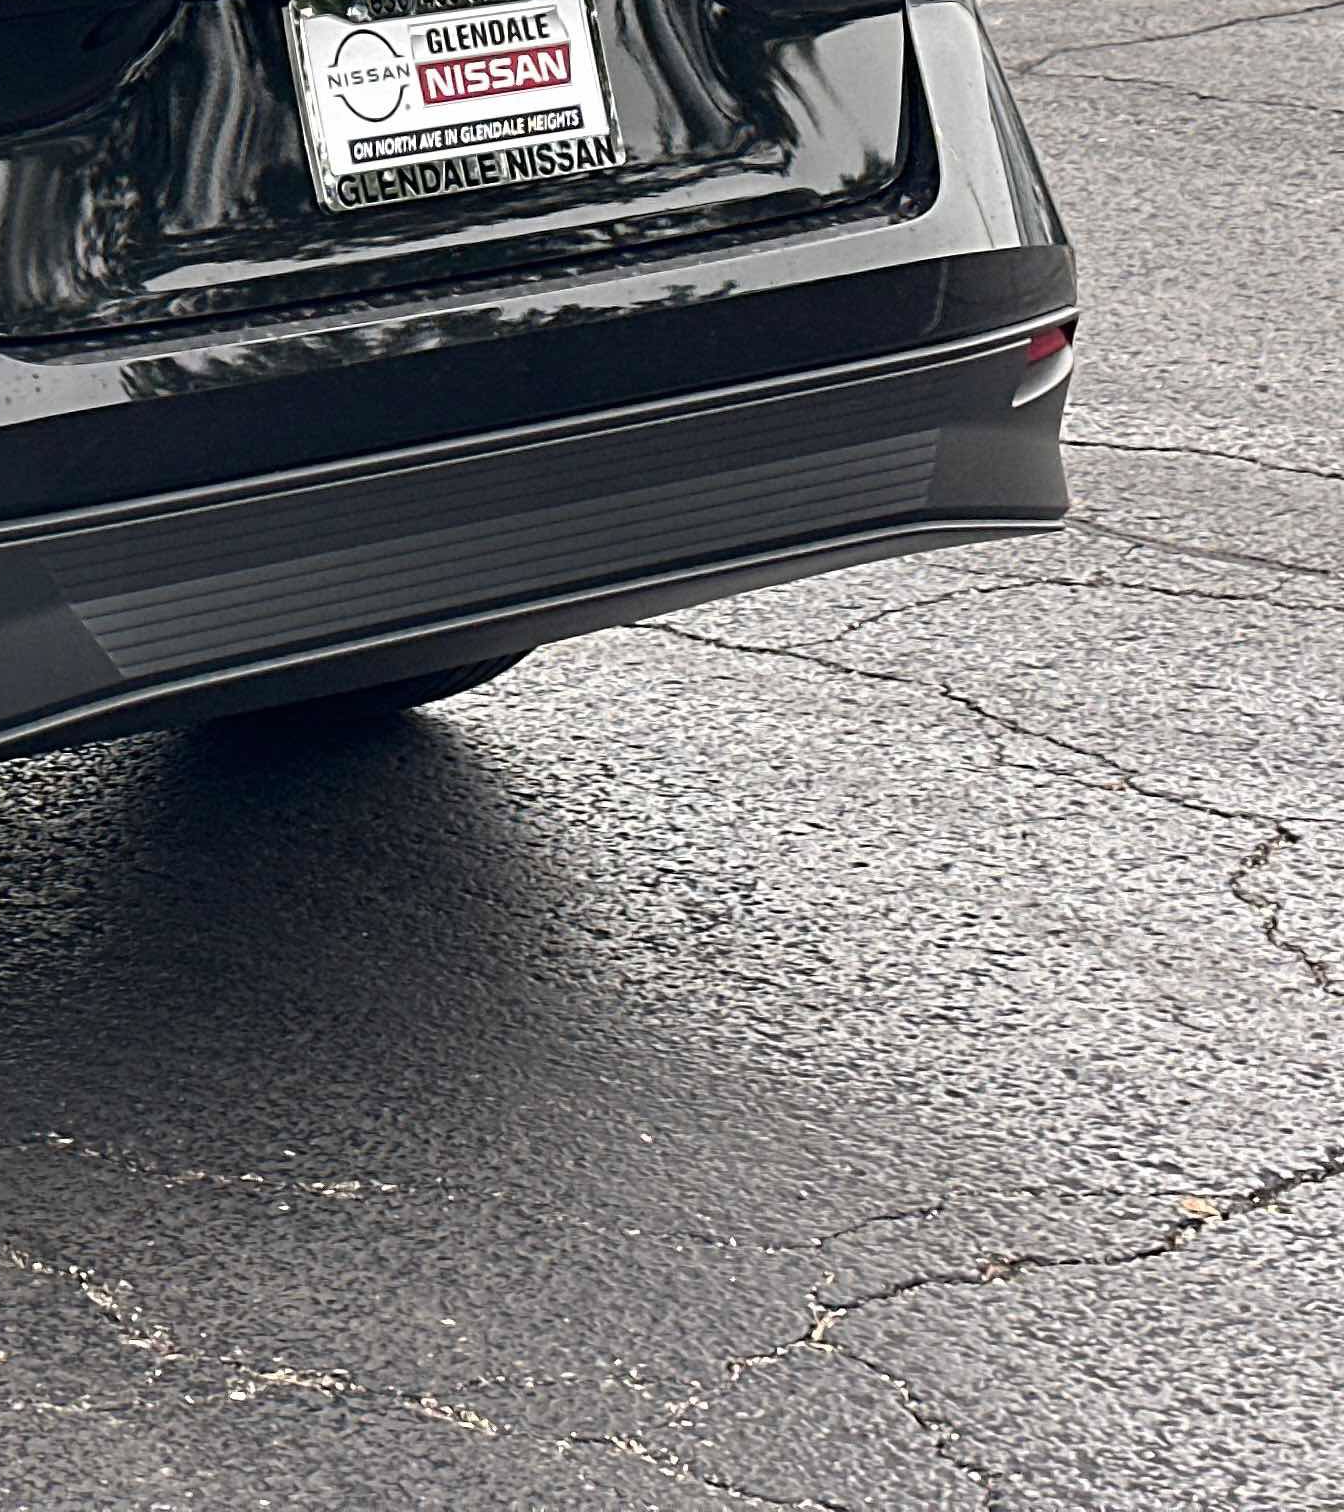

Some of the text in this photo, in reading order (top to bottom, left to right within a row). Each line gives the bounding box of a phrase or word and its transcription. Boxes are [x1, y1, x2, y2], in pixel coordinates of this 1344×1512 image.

[426, 13, 551, 54] GLENDALE
[328, 63, 411, 89] NISSAN
[425, 49, 569, 100] NISSAN
[353, 109, 580, 161] ON NORTH AVE IN GLENDALE HEIGHTS
[337, 134, 617, 207] GLENDALE NISSAN
